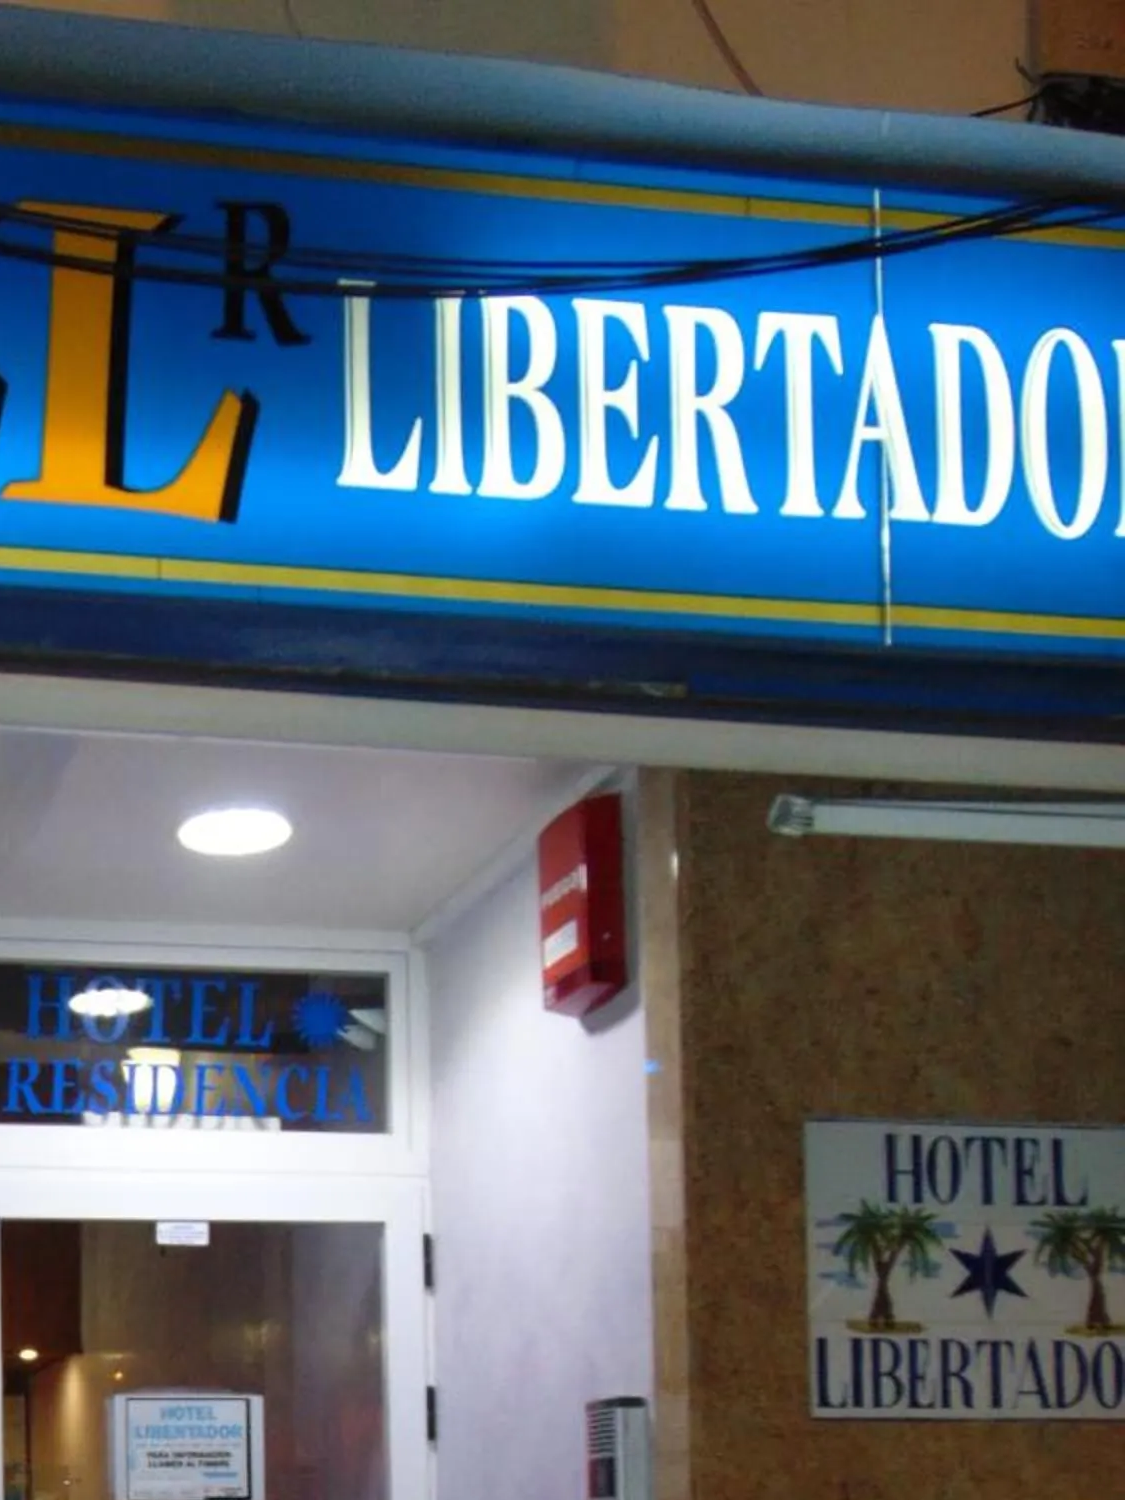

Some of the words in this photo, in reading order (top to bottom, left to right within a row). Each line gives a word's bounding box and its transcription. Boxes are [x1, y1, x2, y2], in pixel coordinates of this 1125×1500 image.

[211, 200, 312, 346] R
[337, 279, 1125, 540] LIBERTADO
[24, 972, 274, 1049] HOTEL
[2, 1057, 375, 1124] RESIDENCIA
[884, 1133, 1089, 1206] HOTEL
[160, 1406, 217, 1421] HOTEL
